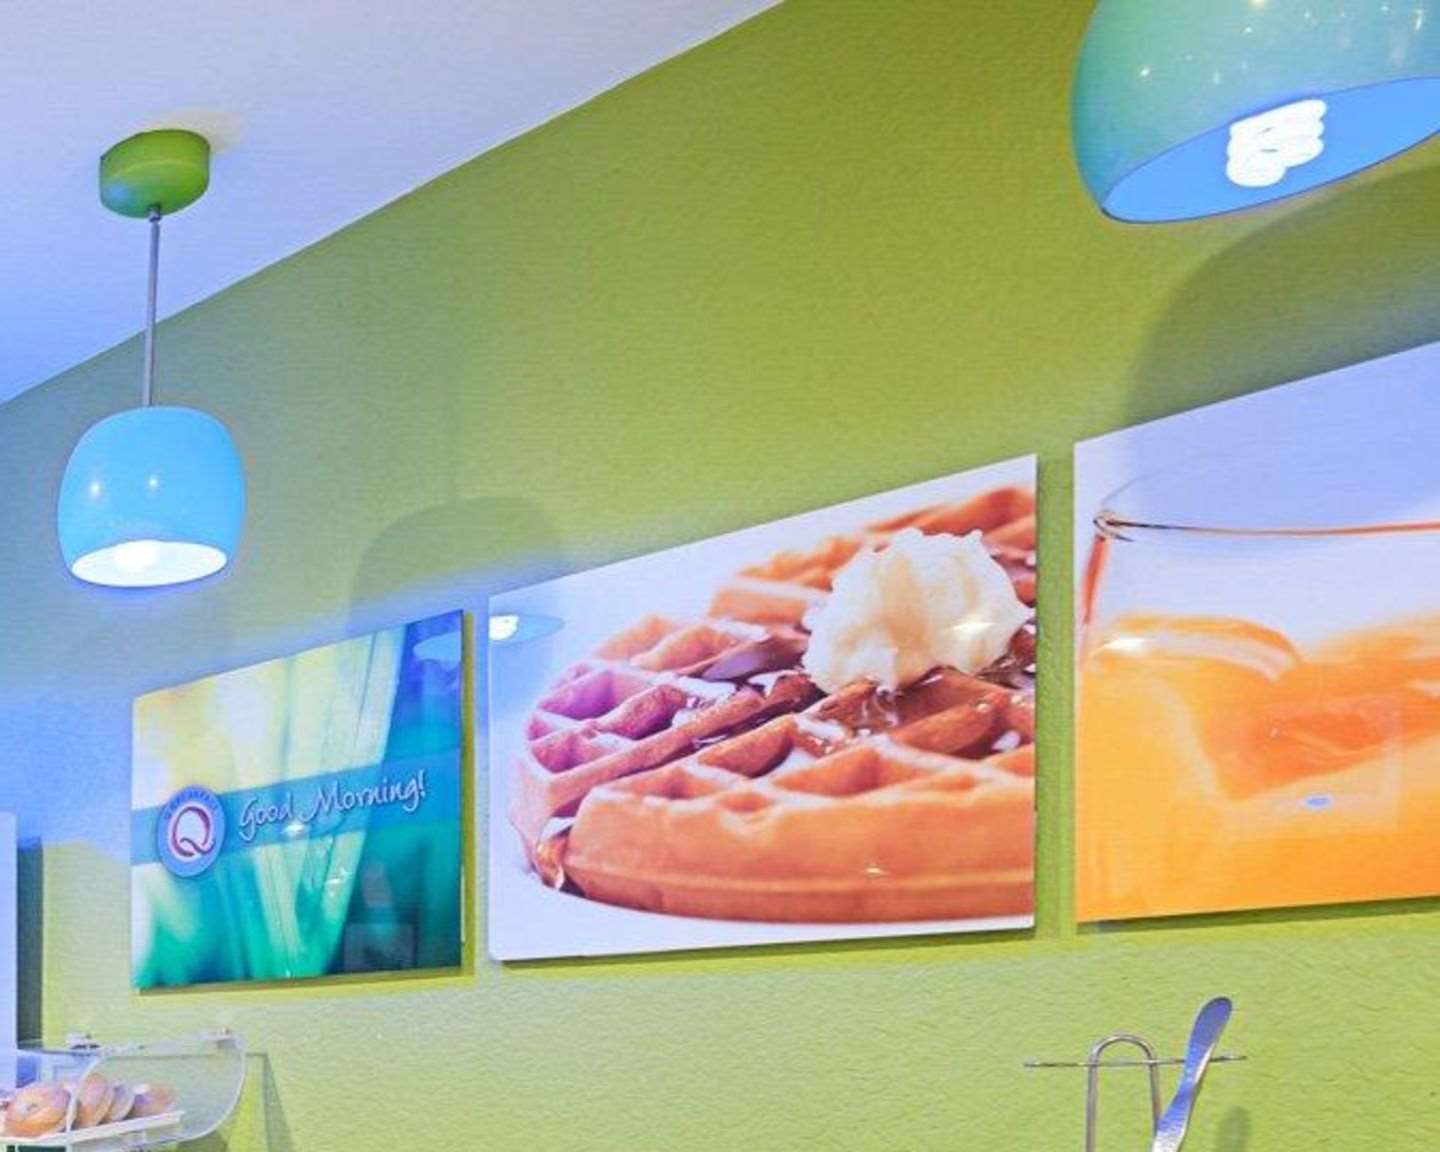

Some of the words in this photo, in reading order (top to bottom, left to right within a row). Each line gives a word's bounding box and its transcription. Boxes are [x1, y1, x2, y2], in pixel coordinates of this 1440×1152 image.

[172, 806, 216, 857] Q
[239, 792, 294, 842] Good
[298, 769, 426, 823] Morning!
